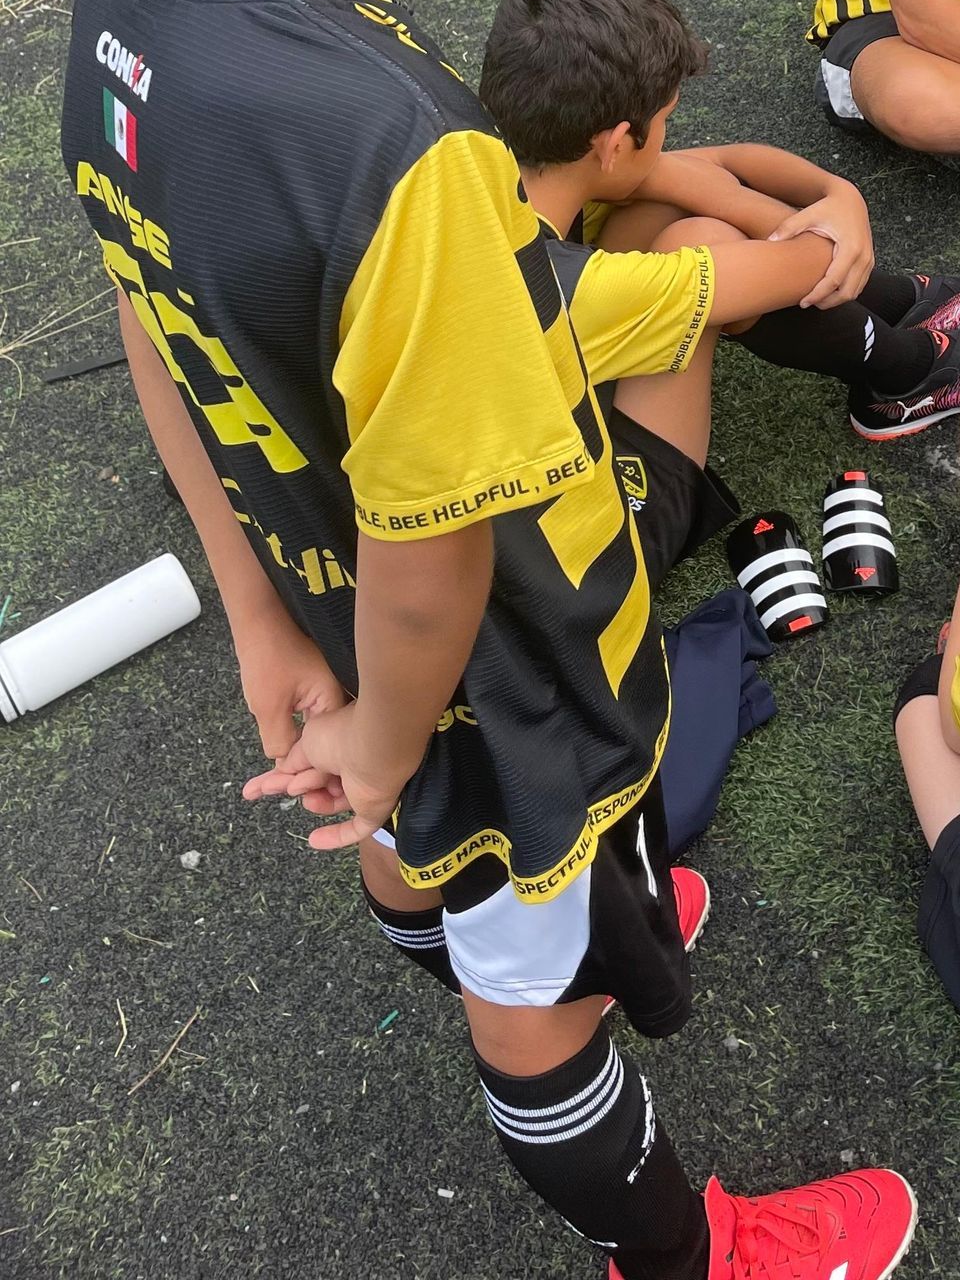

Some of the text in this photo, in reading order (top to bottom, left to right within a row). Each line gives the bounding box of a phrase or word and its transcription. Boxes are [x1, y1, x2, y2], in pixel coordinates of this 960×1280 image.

[690, 310, 704, 329] BEE
[388, 511, 430, 531] BEE
[545, 456, 588, 486] BEE
[418, 858, 455, 881] BEE
